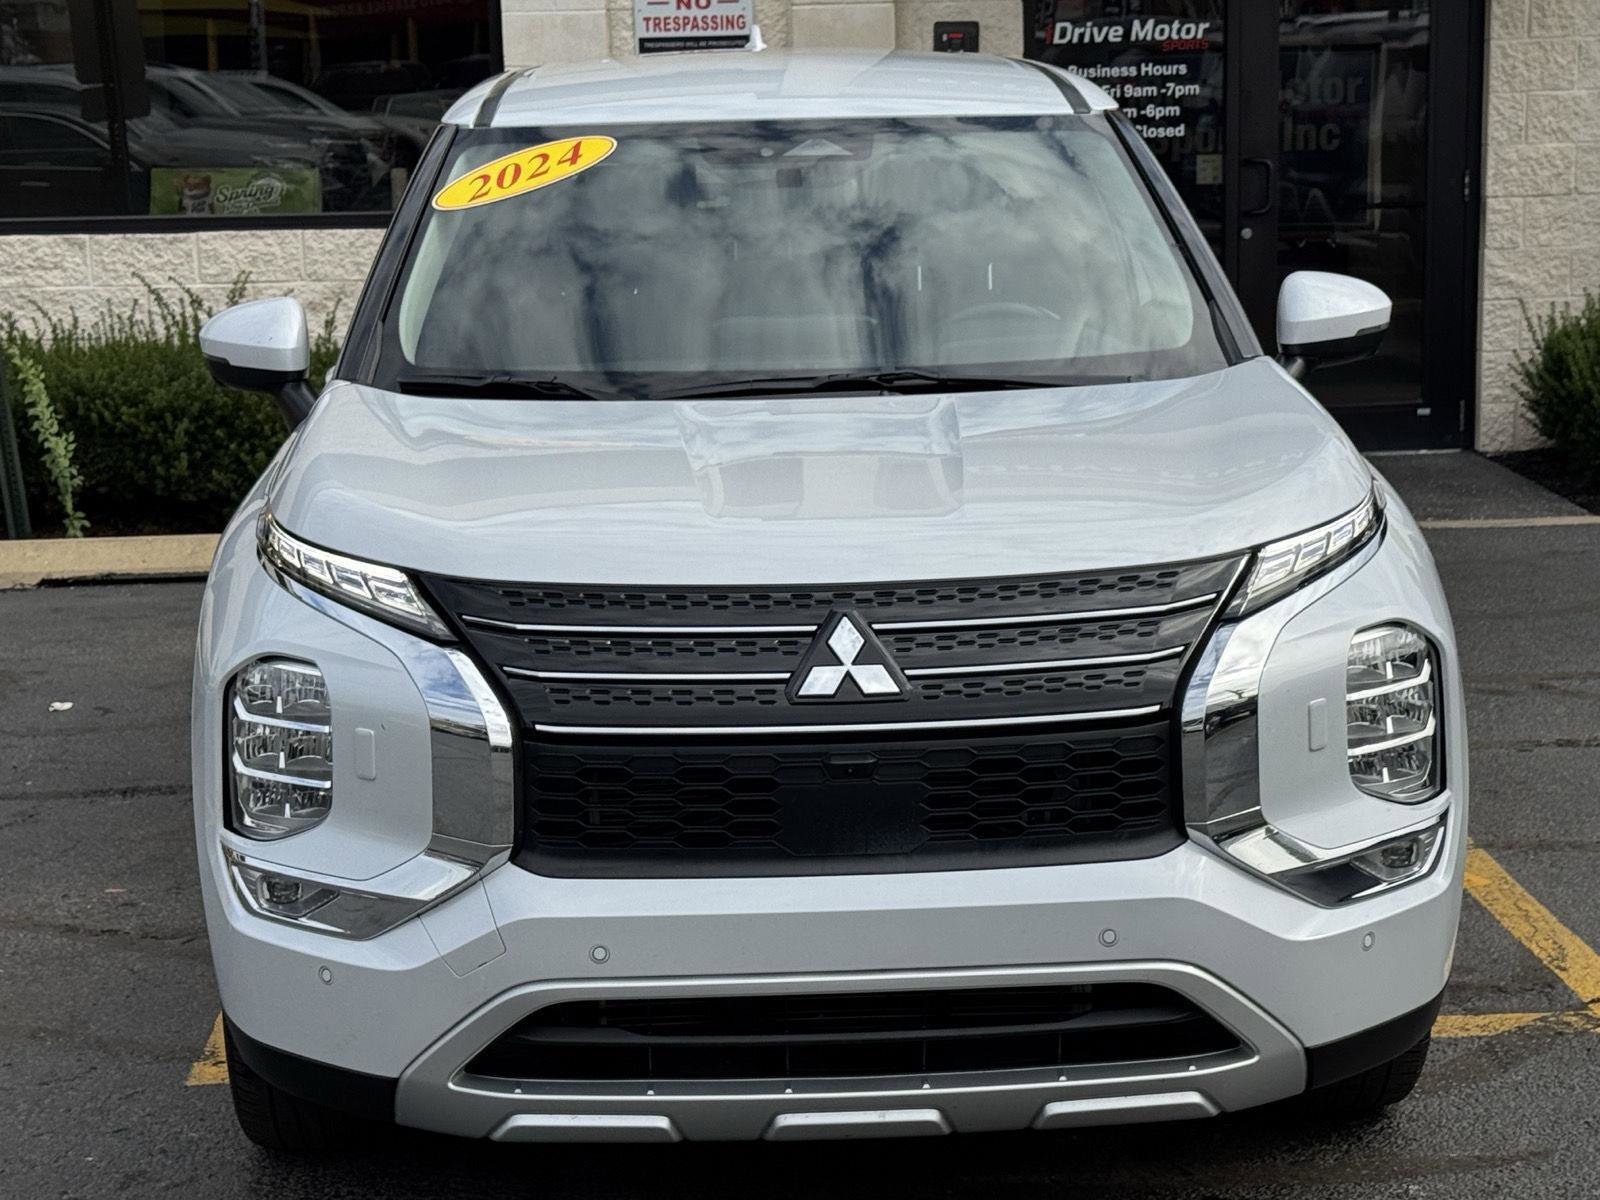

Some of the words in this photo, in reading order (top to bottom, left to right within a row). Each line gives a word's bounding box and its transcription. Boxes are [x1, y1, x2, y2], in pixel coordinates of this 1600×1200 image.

[676, 0, 712, 10] NO
[643, 15, 747, 33] TRESPASSING
[1130, 18, 1211, 42] Motor
[1162, 38, 1209, 52] SPORTS
[1140, 62, 1188, 77] Hours
[1124, 84, 1158, 98] 9am
[468, 140, 584, 203] 2024
[215, 182, 276, 204] Spring
